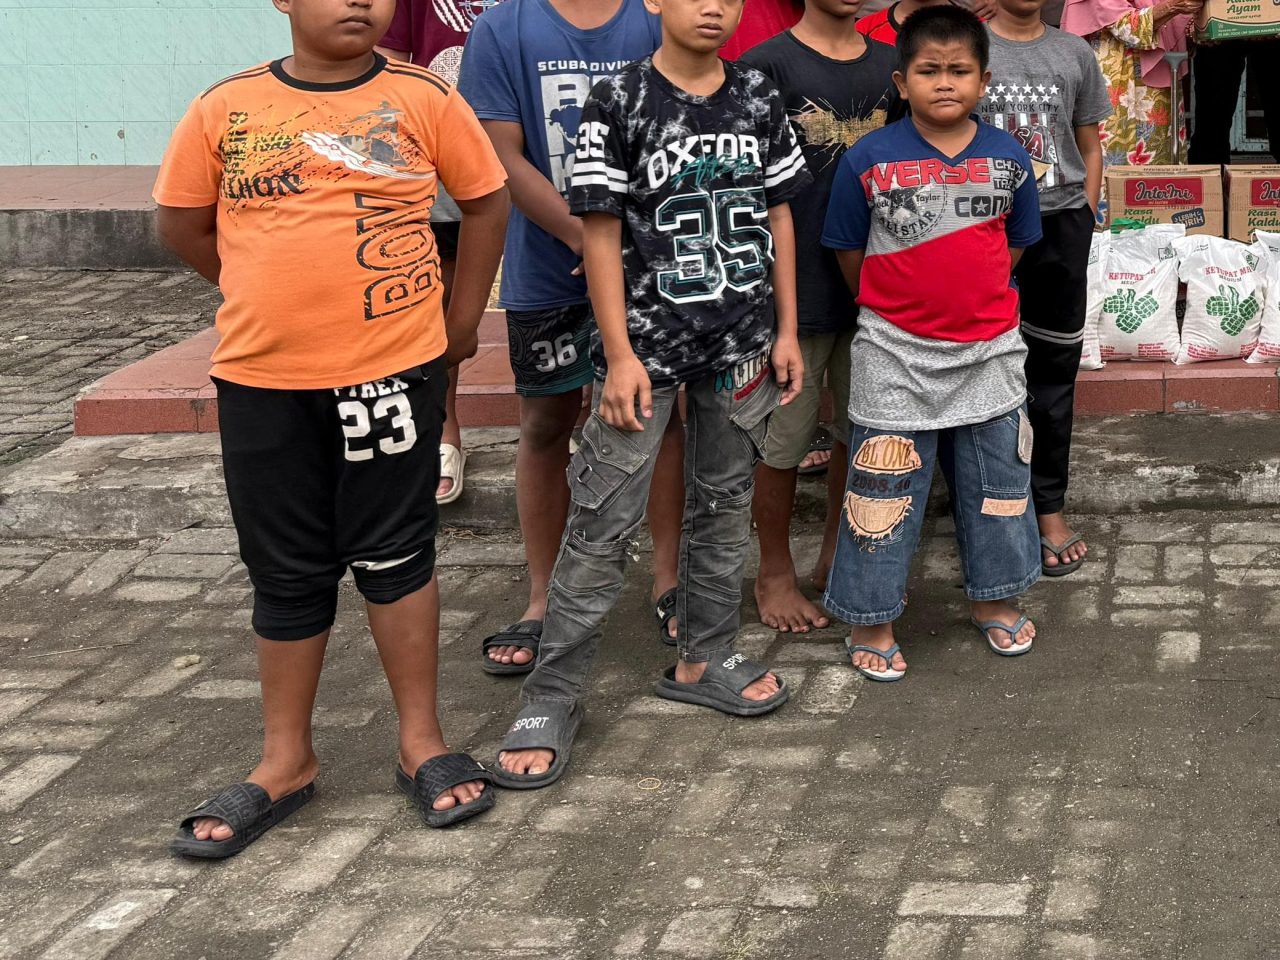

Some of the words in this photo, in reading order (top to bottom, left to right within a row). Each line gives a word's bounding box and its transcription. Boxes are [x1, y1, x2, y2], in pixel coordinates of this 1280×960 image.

[1227, 4, 1260, 15] Ayam
[538, 60, 587, 71] SCUBA
[590, 60, 635, 72] DIVIN
[981, 104, 1005, 112] NEW
[1010, 104, 1035, 112] YORK
[1039, 104, 1059, 113] CITY
[576, 122, 610, 159] 35
[656, 186, 774, 304] 35
[1205, 266, 1237, 277] KETUPAT
[531, 332, 577, 372] 36
[338, 393, 417, 461] 23
[514, 717, 549, 732] SPORT
